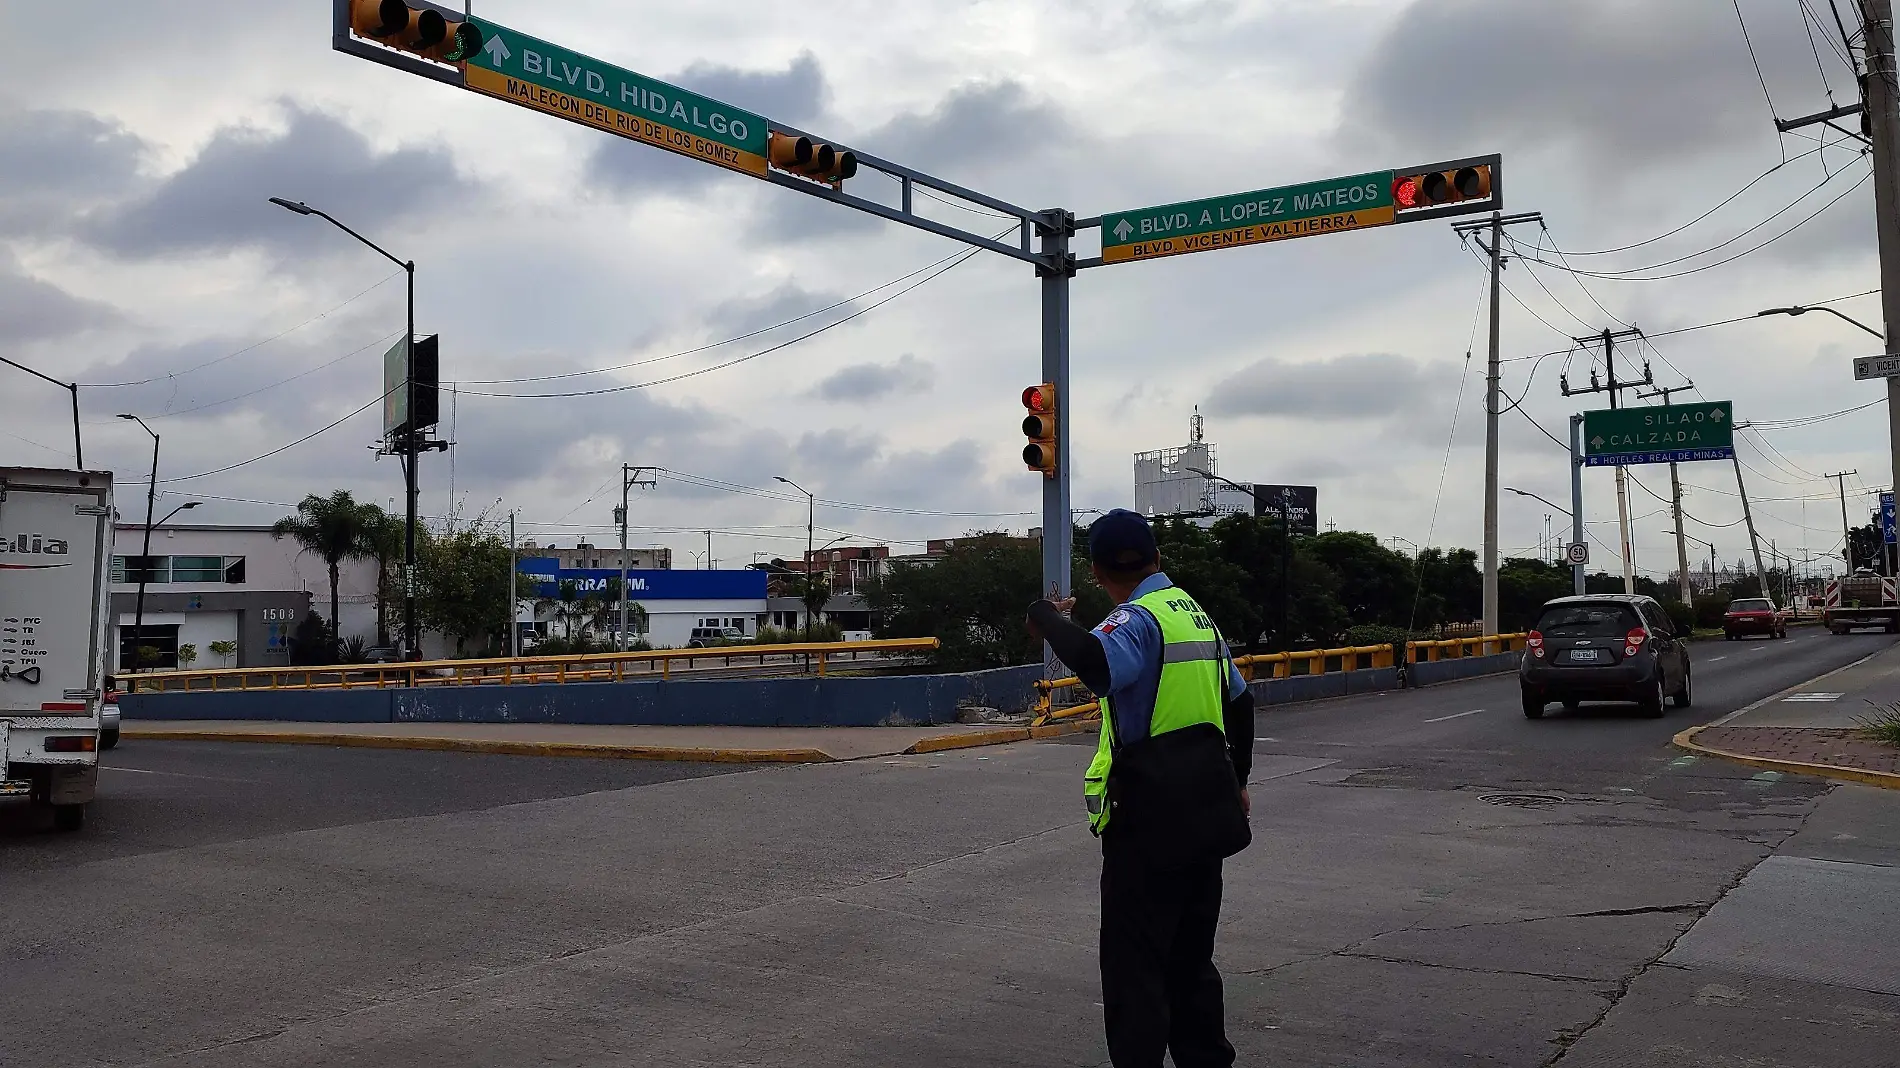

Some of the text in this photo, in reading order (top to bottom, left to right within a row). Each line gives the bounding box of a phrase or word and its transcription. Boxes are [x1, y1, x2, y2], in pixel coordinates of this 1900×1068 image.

[523, 49, 748, 140] BLVD. HIDALGO
[507, 79, 739, 165] MALECON DEL RIO DE LOS GOMEZ
[1140, 183, 1378, 235] BLVD. A LOPEZ MATEOS
[1133, 213, 1358, 256] BLVD. VICENTE VALTIERRA
[1644, 411, 1705, 426] SILAO
[1610, 430, 1701, 446] CALZADA
[1603, 450, 1724, 464] HOTELES REAL DE MINAS
[1573, 547, 1583, 556] 50
[263, 608, 294, 620] 1508
[20, 648, 48, 656] Cuero
